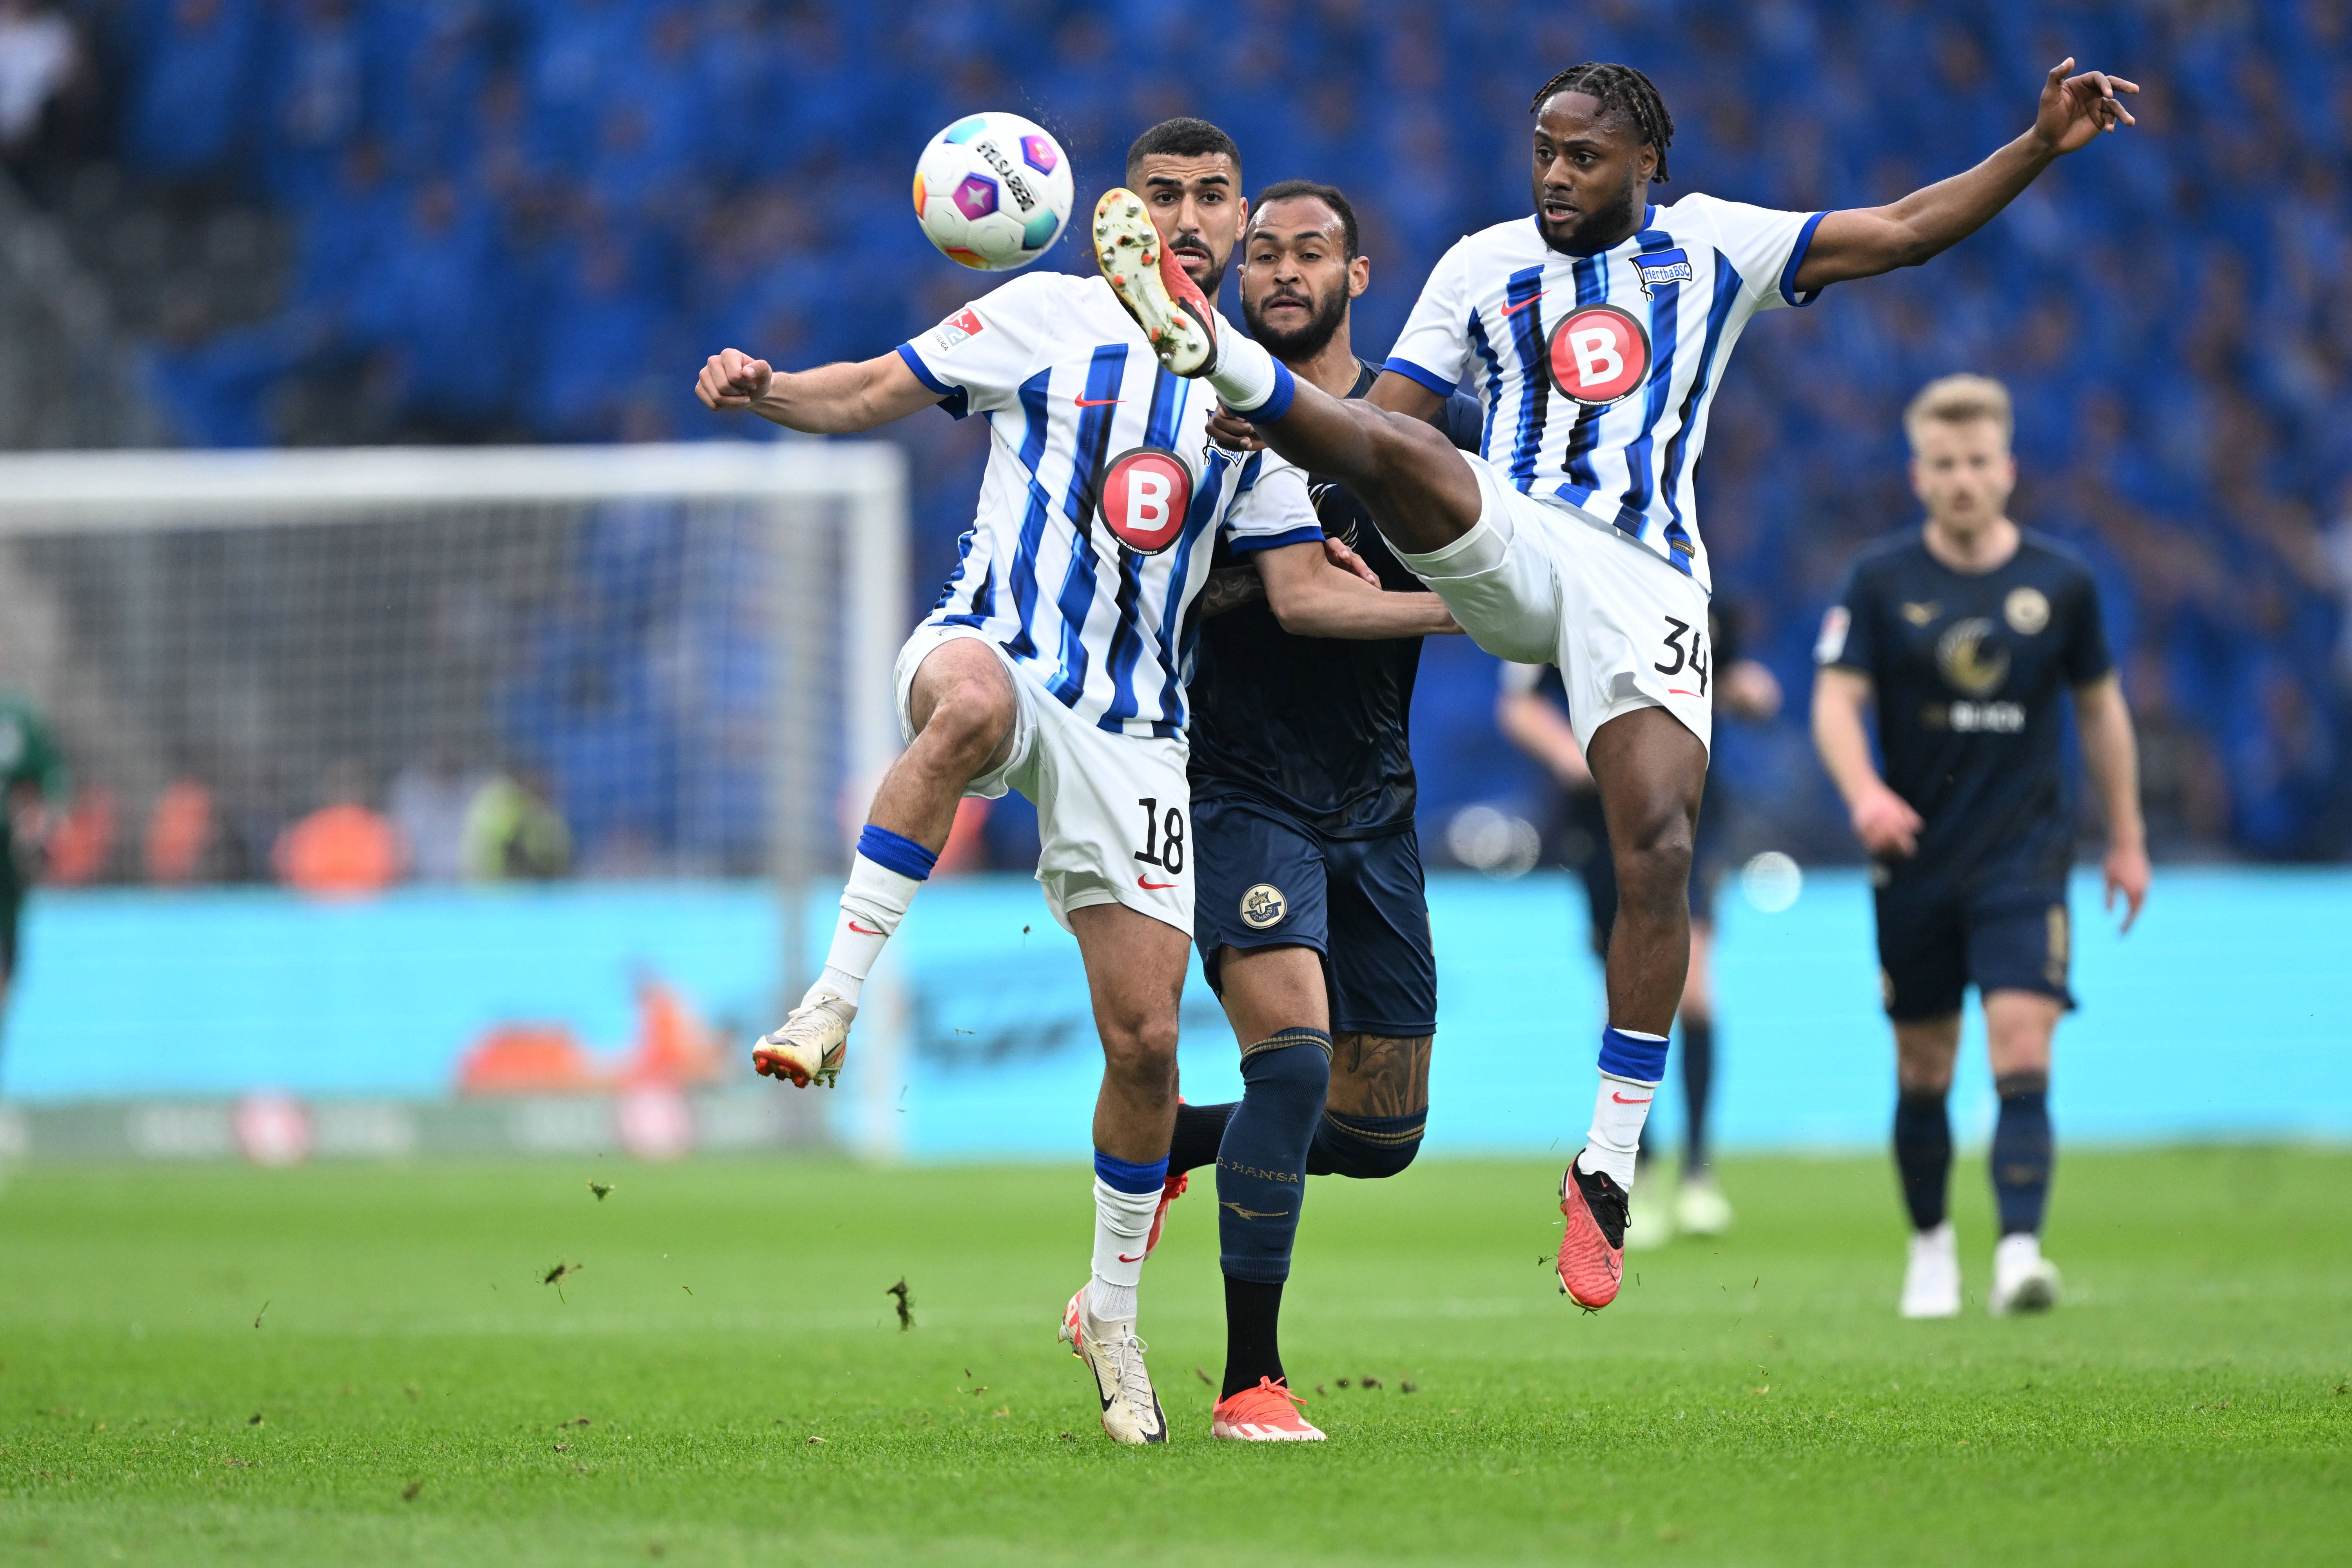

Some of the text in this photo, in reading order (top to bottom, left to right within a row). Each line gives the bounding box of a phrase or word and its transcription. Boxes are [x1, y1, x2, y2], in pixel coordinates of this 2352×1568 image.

[1645, 264, 1690, 281] Hertha BSC
[1570, 327, 1623, 387] B
[1575, 394, 1625, 405] WWW.CRAZYBUZZER.DE
[1126, 470, 1171, 531] B
[1116, 536, 1158, 555] WWW.CRAZYBUZZER.DE
[1654, 615, 1708, 697] 34
[1134, 798, 1183, 875] 18
[1259, 906, 1273, 920] HANSA
[1232, 1161, 1299, 1183] HANSA
